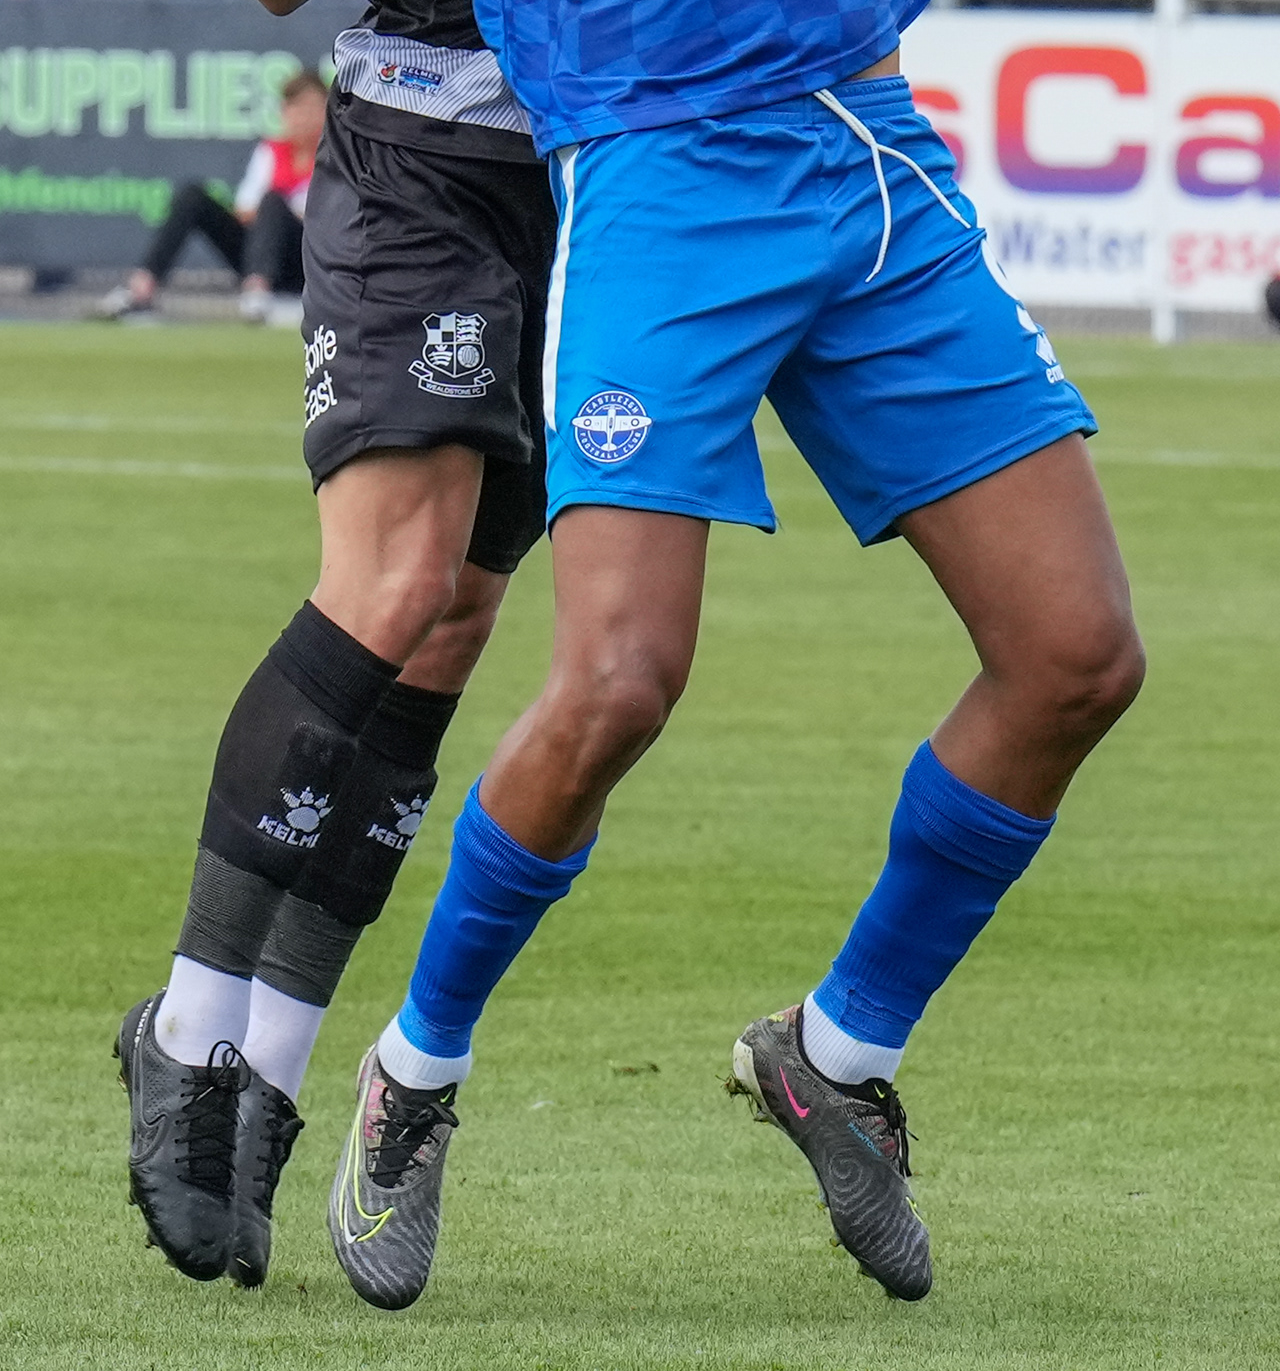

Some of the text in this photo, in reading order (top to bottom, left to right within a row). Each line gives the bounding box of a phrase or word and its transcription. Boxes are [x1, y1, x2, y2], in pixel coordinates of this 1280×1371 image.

[425, 382, 482, 396] WEALDSTONE FC
[584, 394, 640, 414] EASTLEIGH
[579, 431, 642, 460] FOOTBALL CLUB
